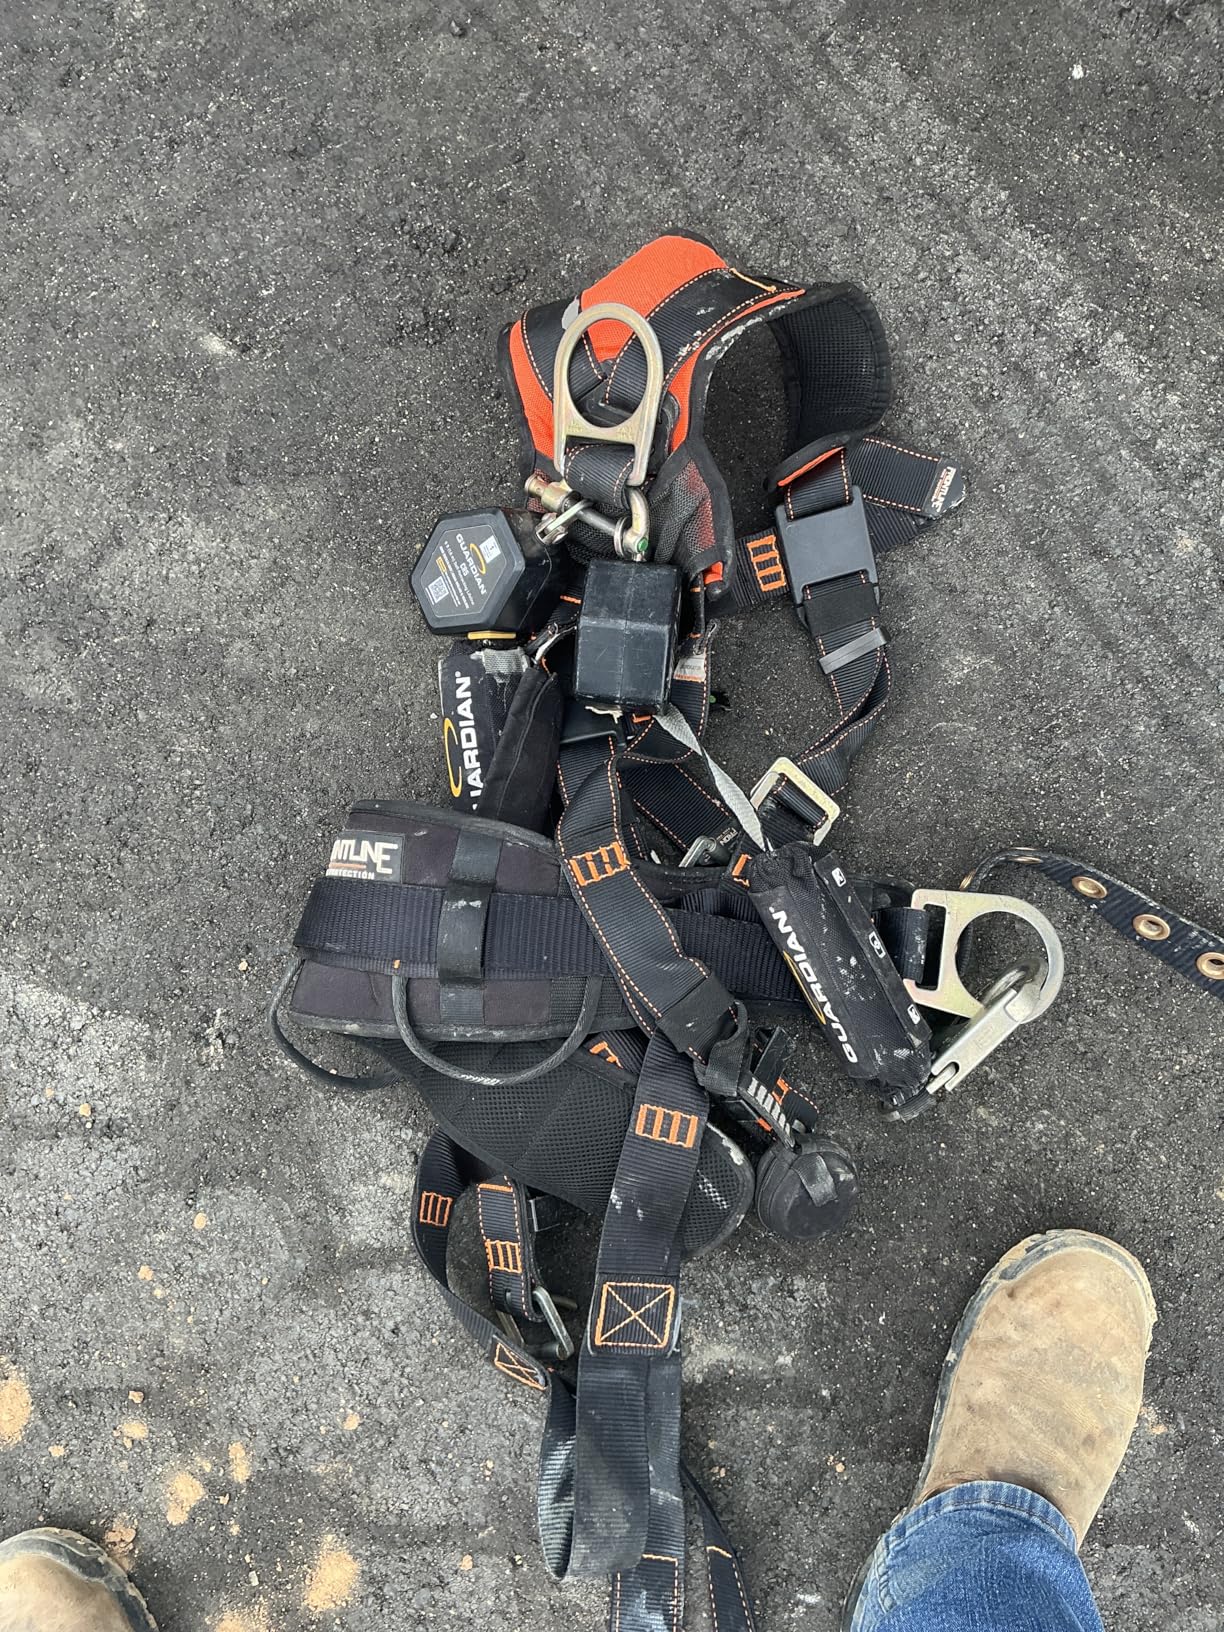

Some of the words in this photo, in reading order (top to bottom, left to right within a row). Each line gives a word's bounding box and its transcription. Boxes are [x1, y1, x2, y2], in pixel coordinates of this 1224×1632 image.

[456, 533, 487, 595] GUARDIAN
[455, 676, 485, 812] ARDIAN
[772, 910, 858, 1063] GUARDIAN
